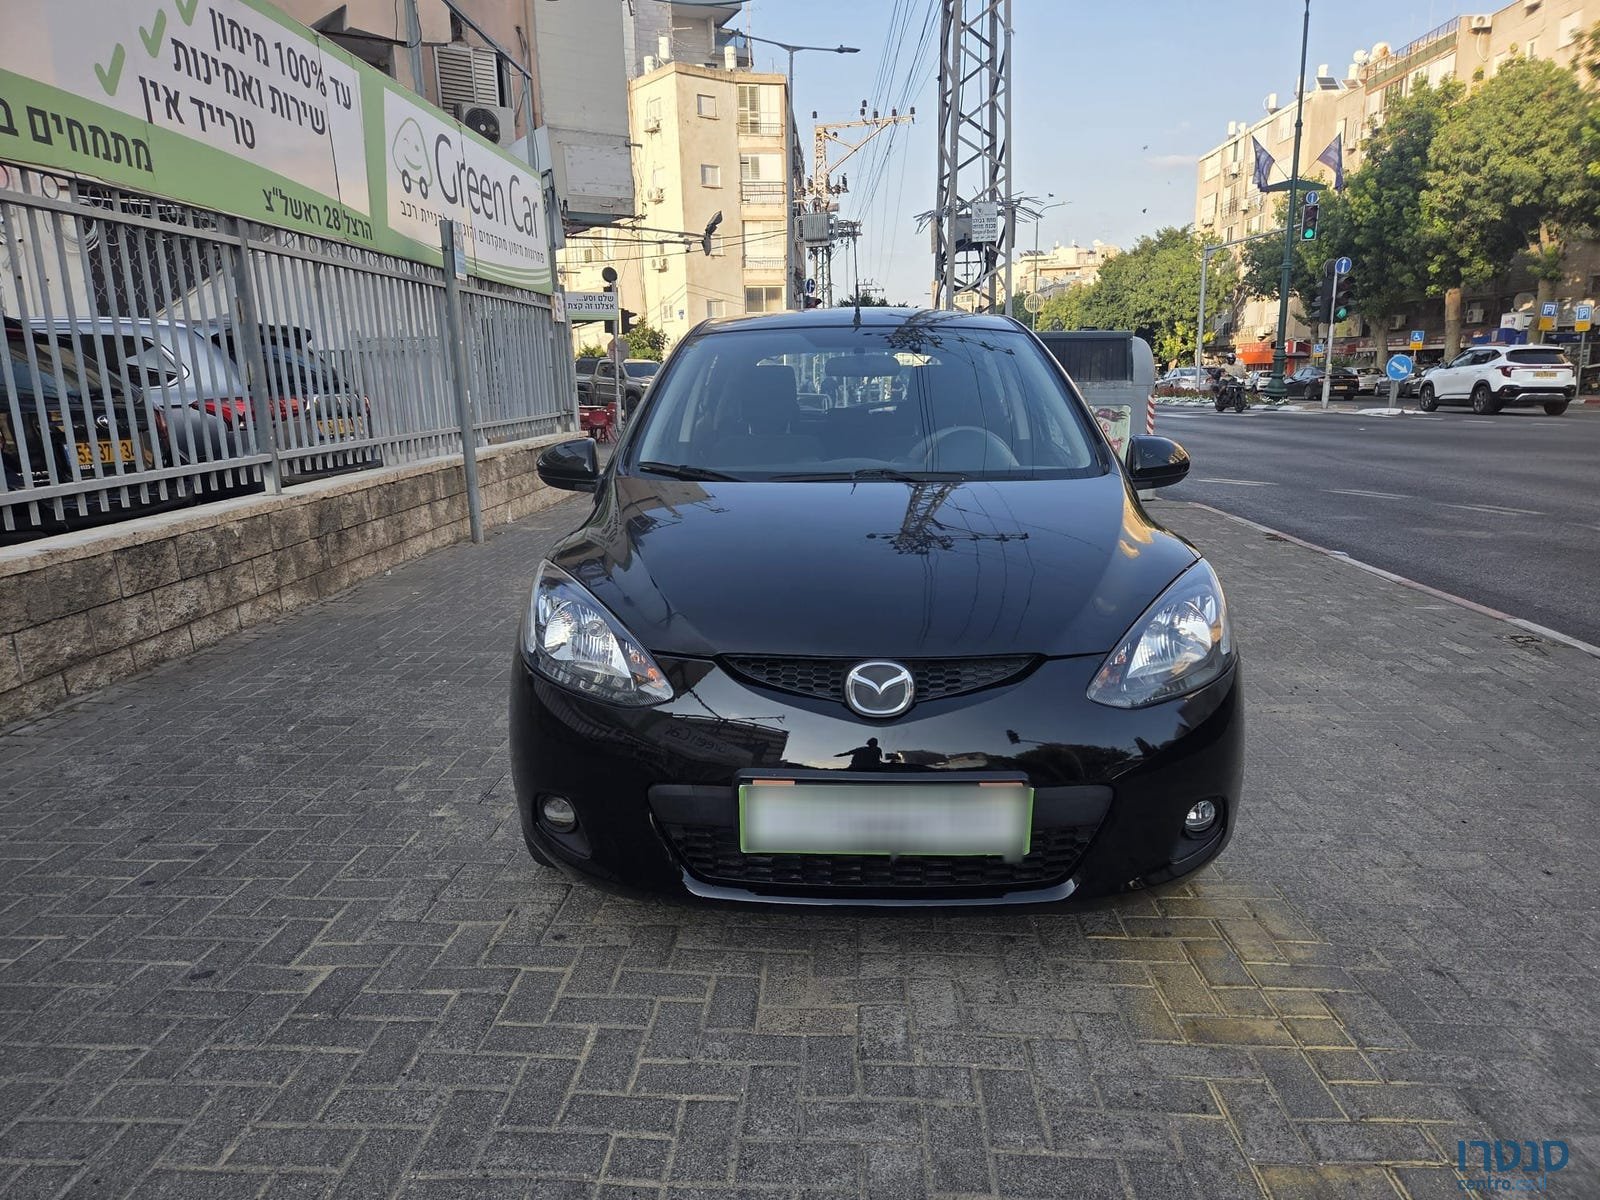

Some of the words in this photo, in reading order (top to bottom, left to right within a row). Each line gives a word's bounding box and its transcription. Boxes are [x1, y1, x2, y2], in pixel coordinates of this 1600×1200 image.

[208, 7, 270, 67] מימון
[170, 37, 265, 109] ואמינות
[274, 41, 327, 97] 100%
[138, 75, 185, 125] אין
[268, 84, 326, 135] שירות
[329, 75, 352, 110] עד
[25, 105, 154, 172] מתמחים
[189, 95, 257, 149] טרייד
[434, 133, 505, 225] Green
[508, 174, 539, 239] Car
[323, 205, 341, 231] 28
[343, 209, 373, 240] הרצל
[400, 200, 418, 220] רכב
[567, 302, 583, 311] קצת
[584, 302, 593, 310] זה
[594, 302, 615, 310] אצלנו
[597, 294, 615, 302] שלם
